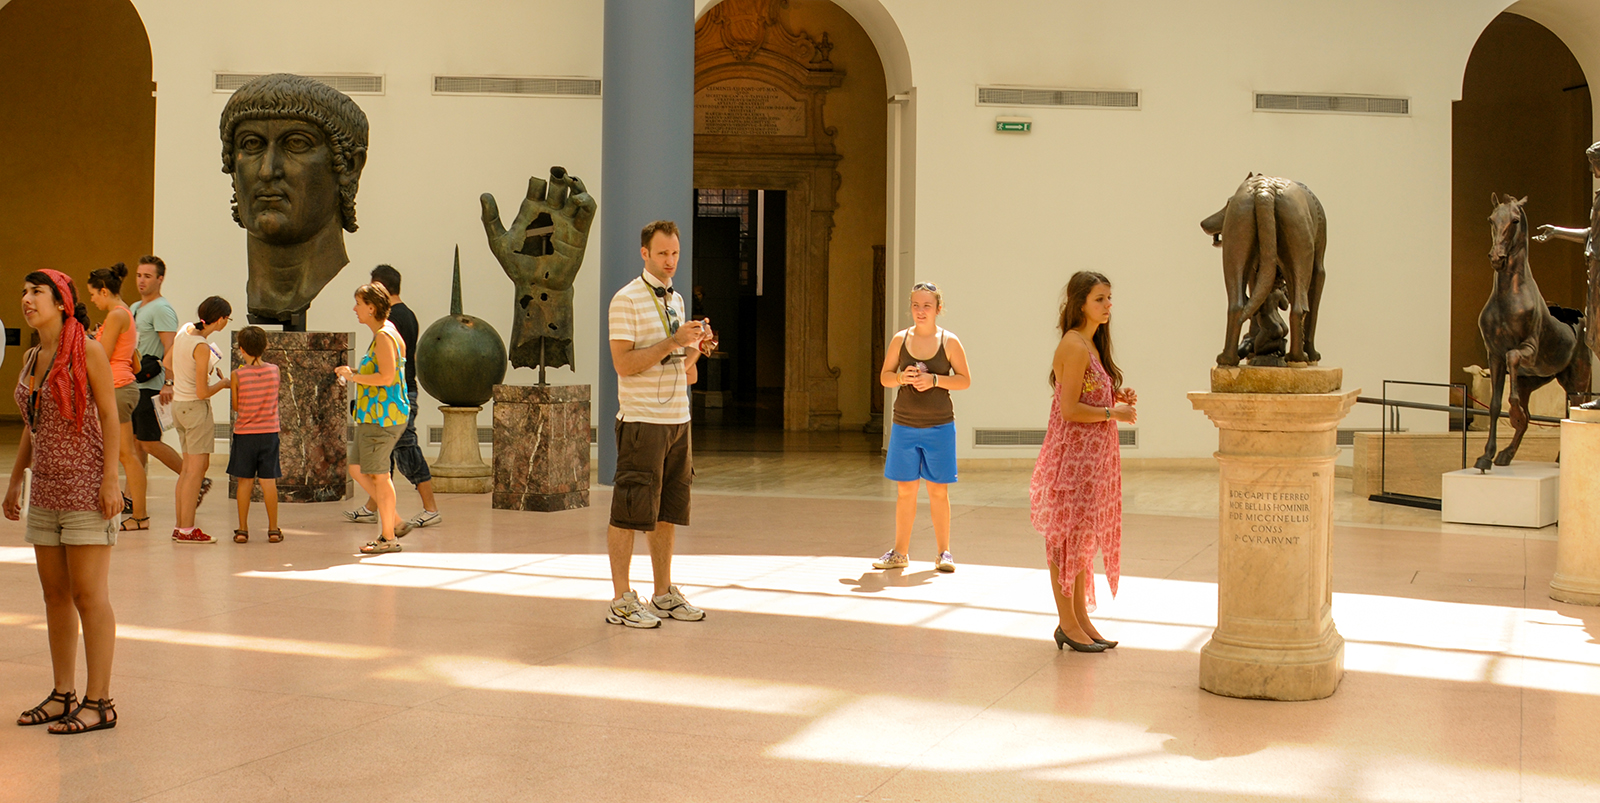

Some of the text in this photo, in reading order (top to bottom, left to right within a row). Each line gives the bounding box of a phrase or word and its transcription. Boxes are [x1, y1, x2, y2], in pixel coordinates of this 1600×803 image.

[1280, 492, 1310, 501] FERREO
[1245, 502, 1272, 511] BELLIS
[1245, 513, 1310, 523] MICCINELLIS
[1250, 524, 1283, 534] CONSS
